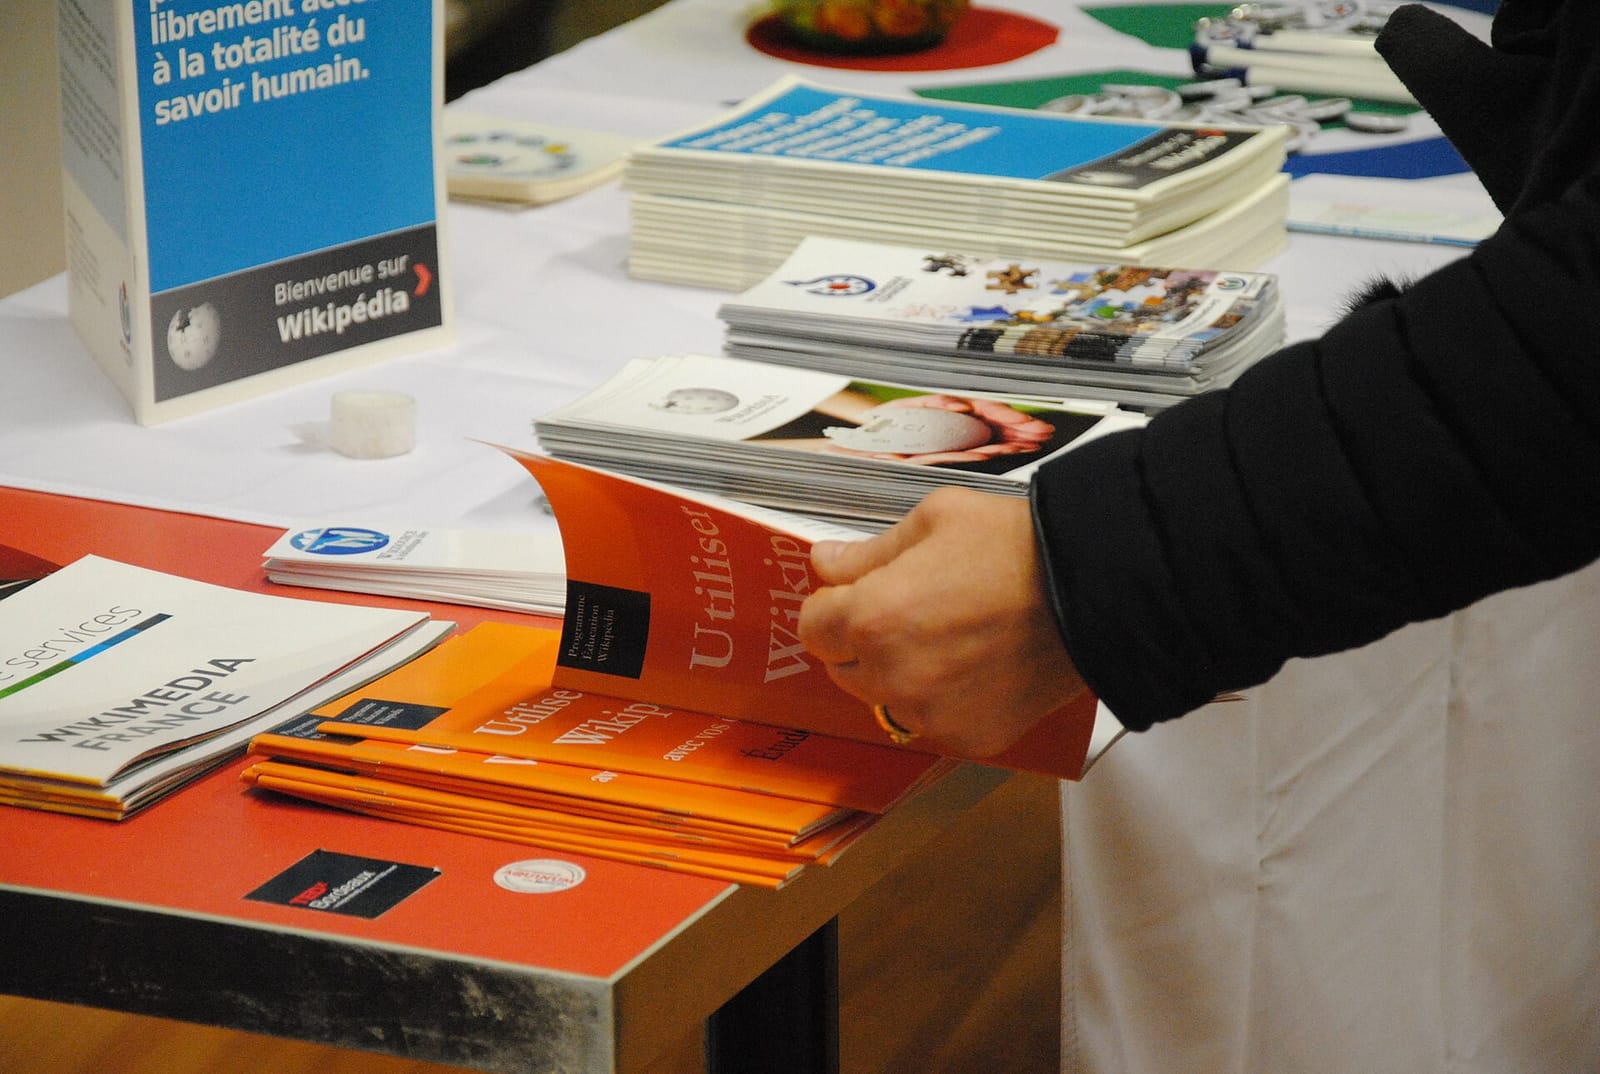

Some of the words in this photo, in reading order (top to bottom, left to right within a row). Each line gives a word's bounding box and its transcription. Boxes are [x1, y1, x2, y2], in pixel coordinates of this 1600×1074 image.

[151, 0, 295, 45] librement
[153, 52, 171, 85] à
[178, 48, 205, 79] la
[211, 19, 320, 71] totalité
[327, 14, 366, 48] du
[155, 78, 245, 125] savoir
[252, 54, 370, 102] humain.
[274, 264, 374, 305] Bienvenue
[377, 254, 409, 279] sur
[277, 287, 410, 343] Wikipédia
[680, 505, 735, 670] Utiliser
[5, 605, 142, 669] services
[568, 594, 586, 657] Programme
[18, 658, 257, 743] WIKIMEDIA
[72, 691, 250, 751] FRANCE
[663, 739, 704, 762] avec
[695, 723, 731, 739] vos
